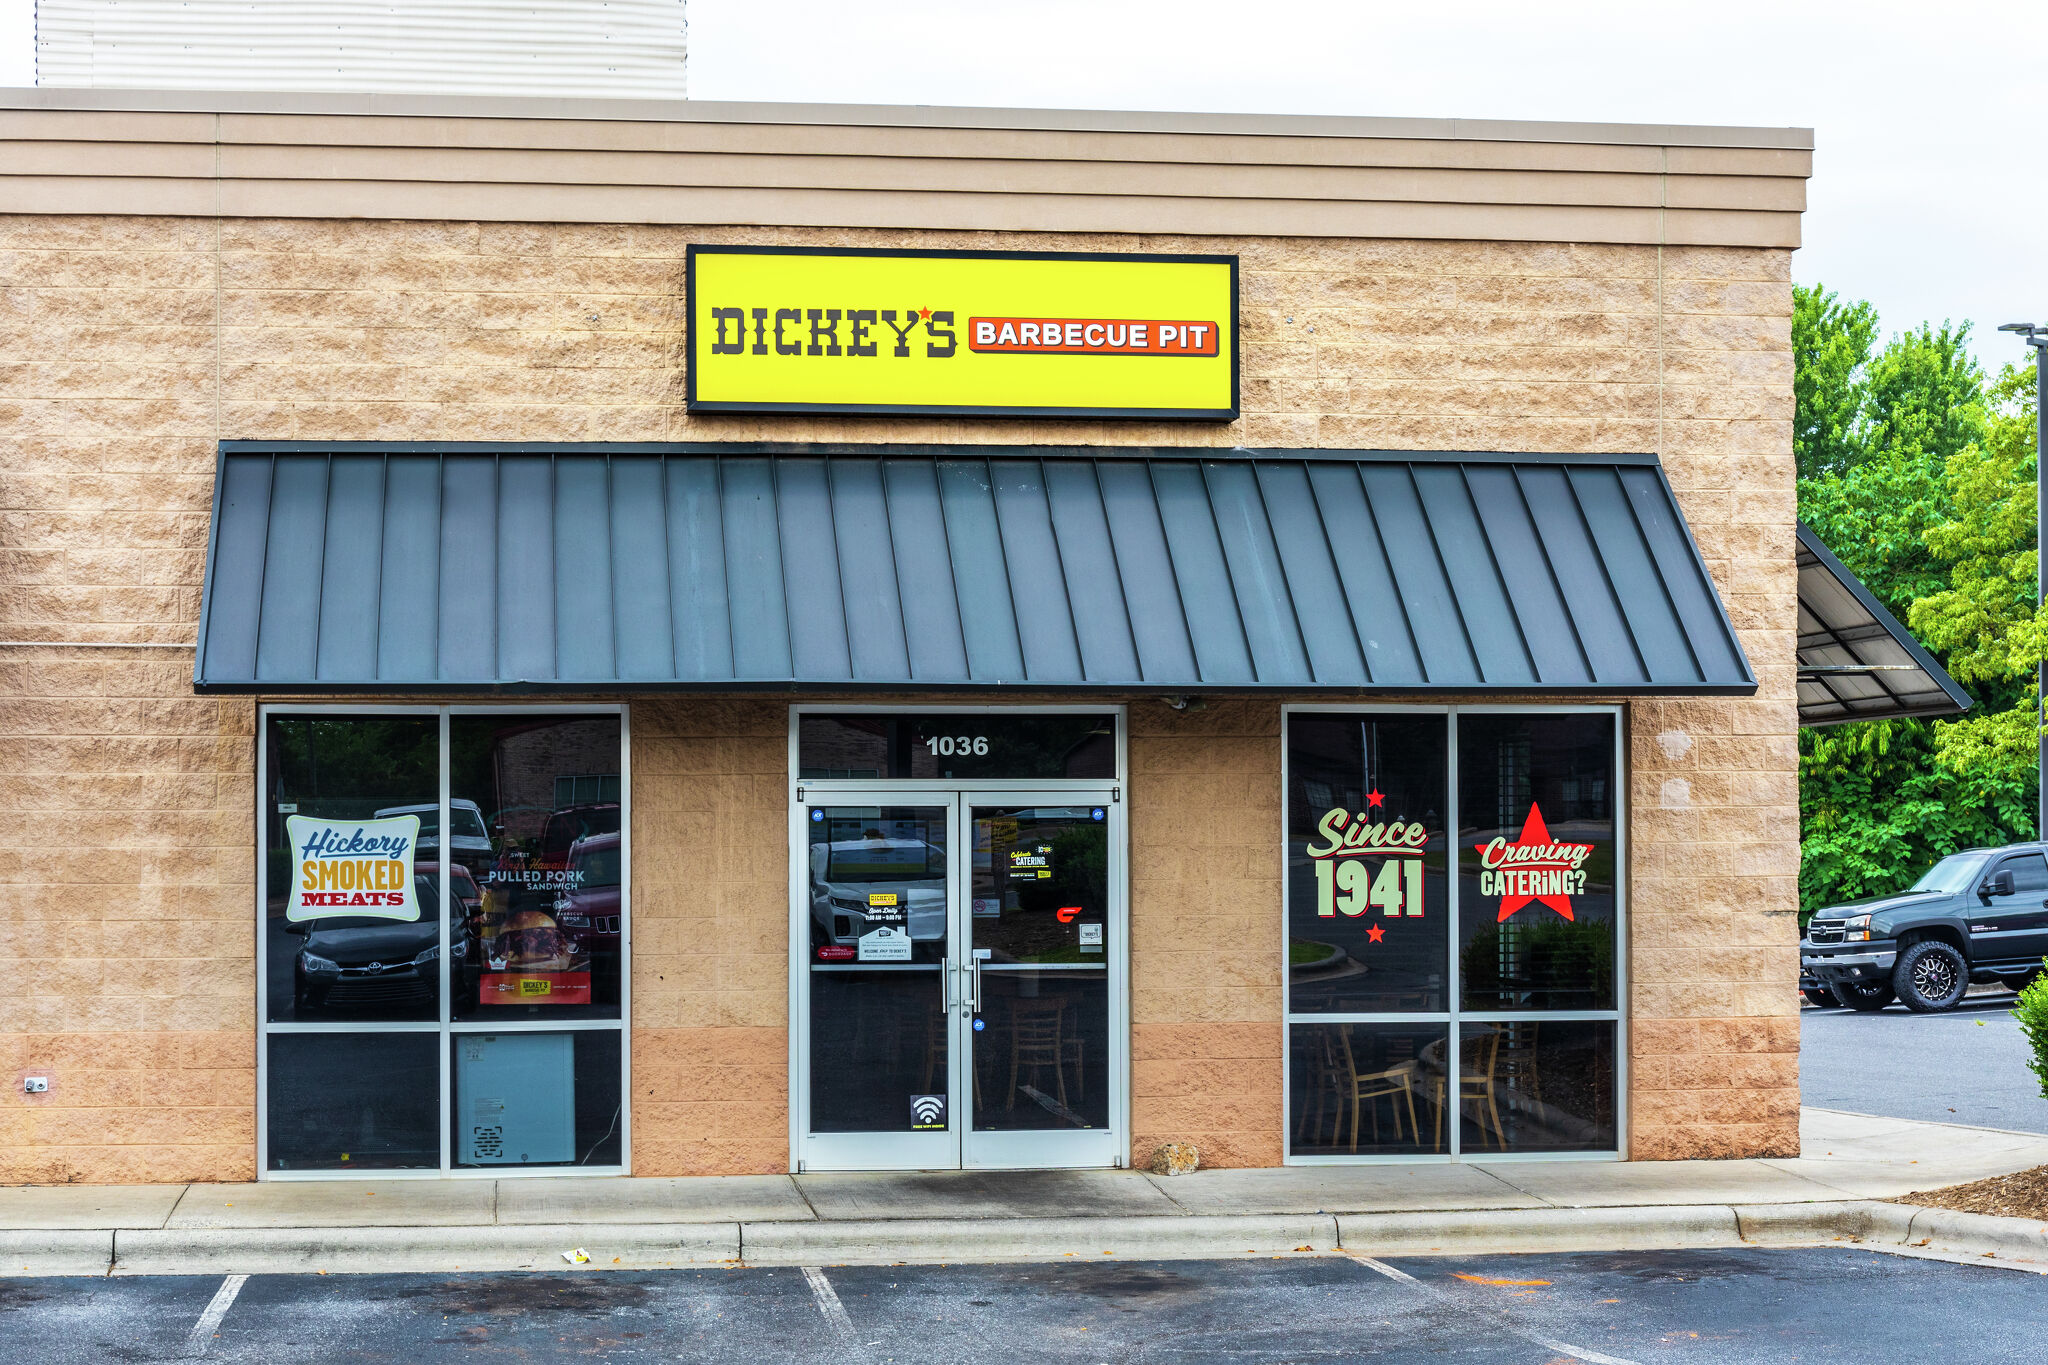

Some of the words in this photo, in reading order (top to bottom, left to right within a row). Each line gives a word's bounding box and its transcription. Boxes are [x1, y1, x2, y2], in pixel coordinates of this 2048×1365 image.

[711, 307, 958, 358] DICKEY'S
[976, 320, 1149, 349] BARBECUE
[1158, 325, 1209, 349] PIT
[926, 736, 989, 756] 1036
[301, 828, 409, 860] Hickory
[1306, 807, 1428, 859] Since
[1016, 857, 1046, 865] CATERING
[1481, 836, 1590, 870] Craving
[302, 860, 405, 890] SMOKED
[489, 870, 541, 882] PULLED
[546, 870, 585, 882] PORK
[527, 882, 578, 891] SANDWICH
[1315, 859, 1424, 918] 1941
[301, 892, 405, 907] MEATS
